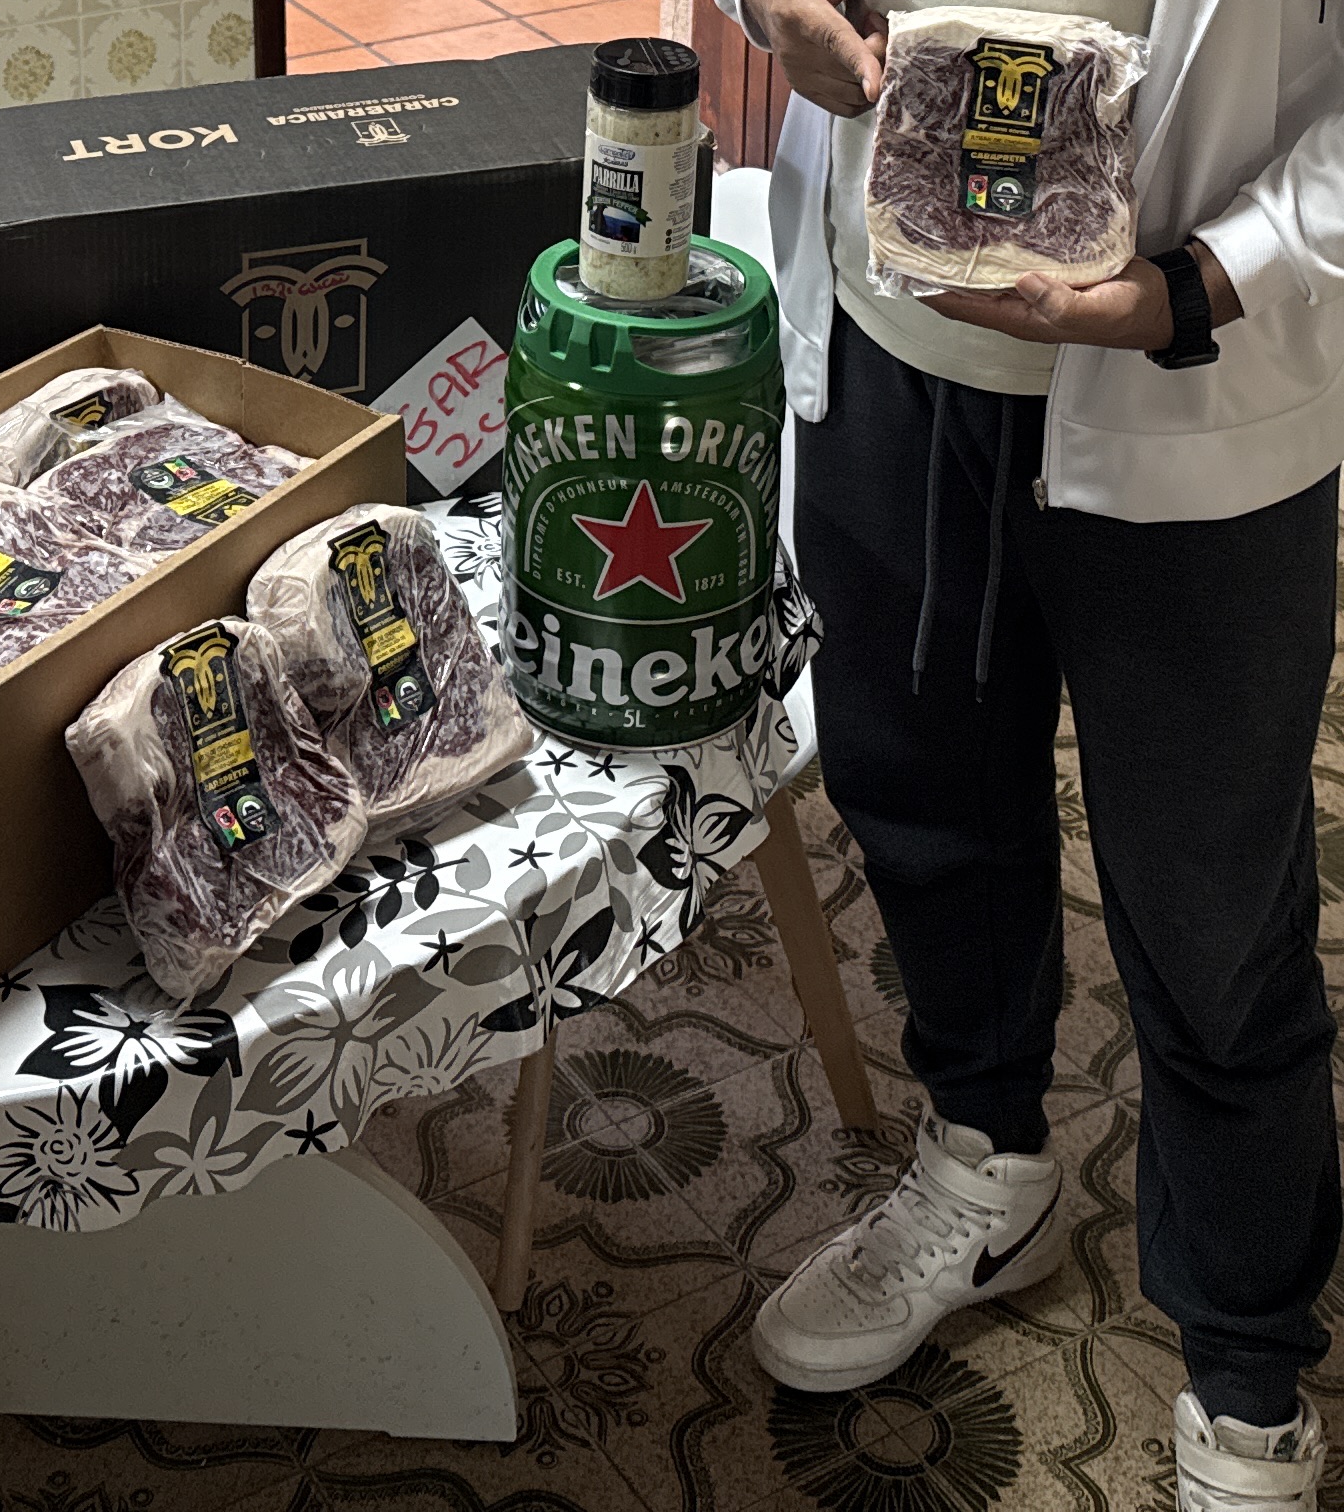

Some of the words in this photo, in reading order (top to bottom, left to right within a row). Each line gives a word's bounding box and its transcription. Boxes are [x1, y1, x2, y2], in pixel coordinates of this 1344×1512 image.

[266, 95, 460, 126] CARABRANCA
[983, 104, 993, 114] C
[1021, 108, 1030, 117] P
[62, 123, 239, 162] KORT
[593, 164, 640, 193] PARRILLA
[503, 414, 637, 542] HEINEKEN
[660, 480, 740, 521] AMSTERDAM
[532, 510, 551, 580] DIPLOME
[545, 479, 629, 513] D'HONNEUR
[556, 567, 586, 589] EST.
[694, 573, 725, 592] 1873
[506, 610, 769, 708] eineke
[622, 708, 646, 729] 5L
